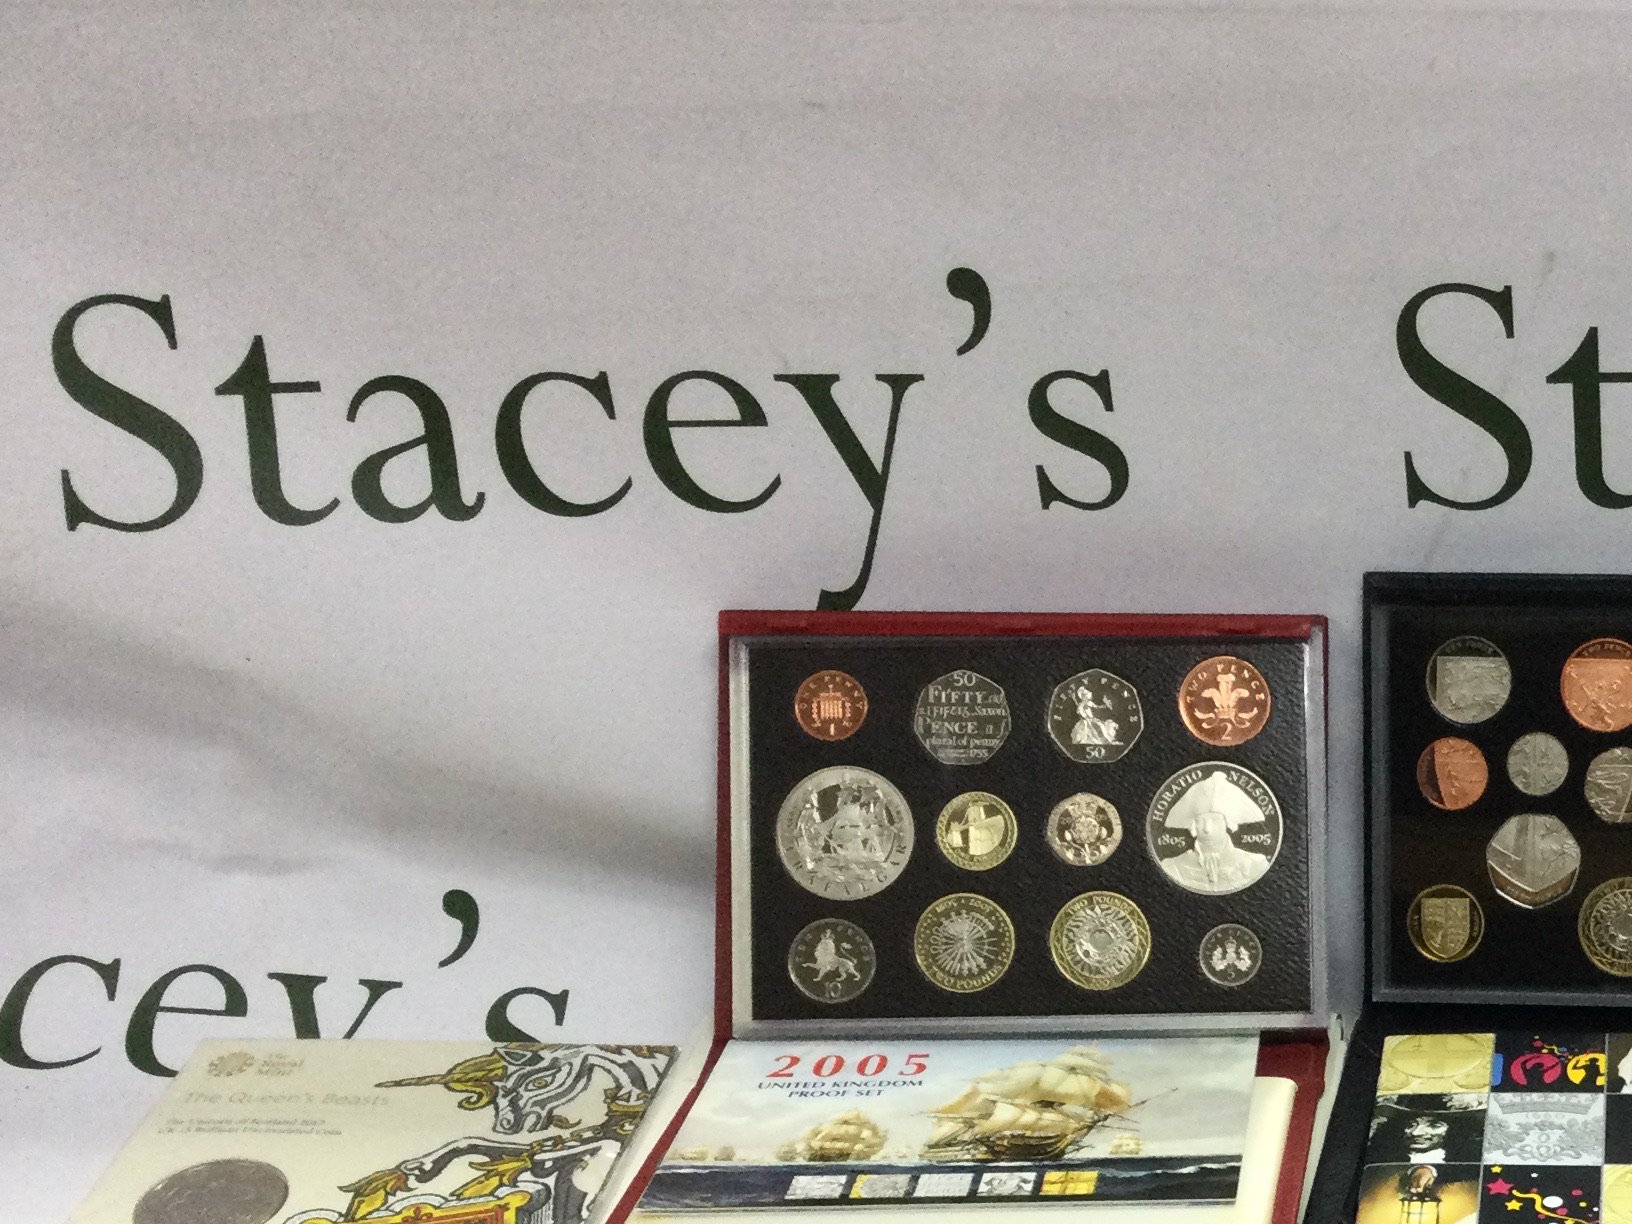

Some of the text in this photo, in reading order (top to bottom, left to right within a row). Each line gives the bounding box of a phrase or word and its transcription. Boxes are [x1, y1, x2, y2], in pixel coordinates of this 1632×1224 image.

[50, 265, 1131, 612] Stacey's
[953, 671, 977, 687] 50
[1221, 723, 1233, 741] 2
[1084, 746, 1107, 760] 50
[1151, 769, 1276, 823] HORATIO NELSON
[1240, 832, 1273, 846] 2005
[824, 981, 843, 998] 10
[766, 1052, 931, 1079] 2005
[757, 1079, 924, 1090] UNITED KINGDOM
[787, 1088, 886, 1099] PROOF SET
